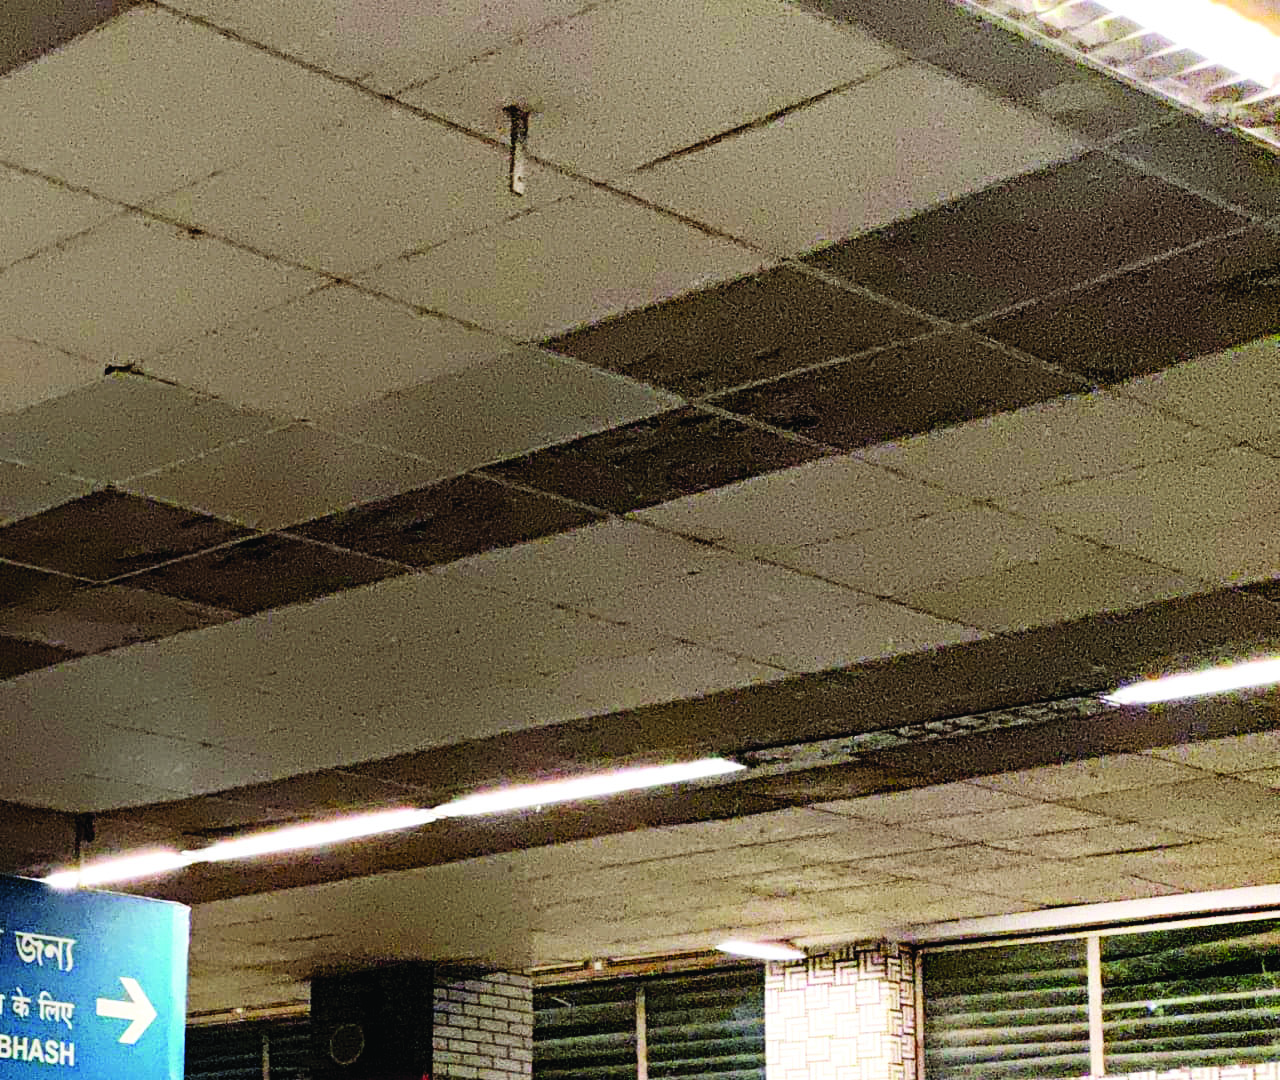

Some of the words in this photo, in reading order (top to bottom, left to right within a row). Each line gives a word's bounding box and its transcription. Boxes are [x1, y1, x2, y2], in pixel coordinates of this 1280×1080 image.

[14, 930, 78, 972] জন্য
[12, 986, 31, 1018] के
[37, 990, 75, 1030] लिए
